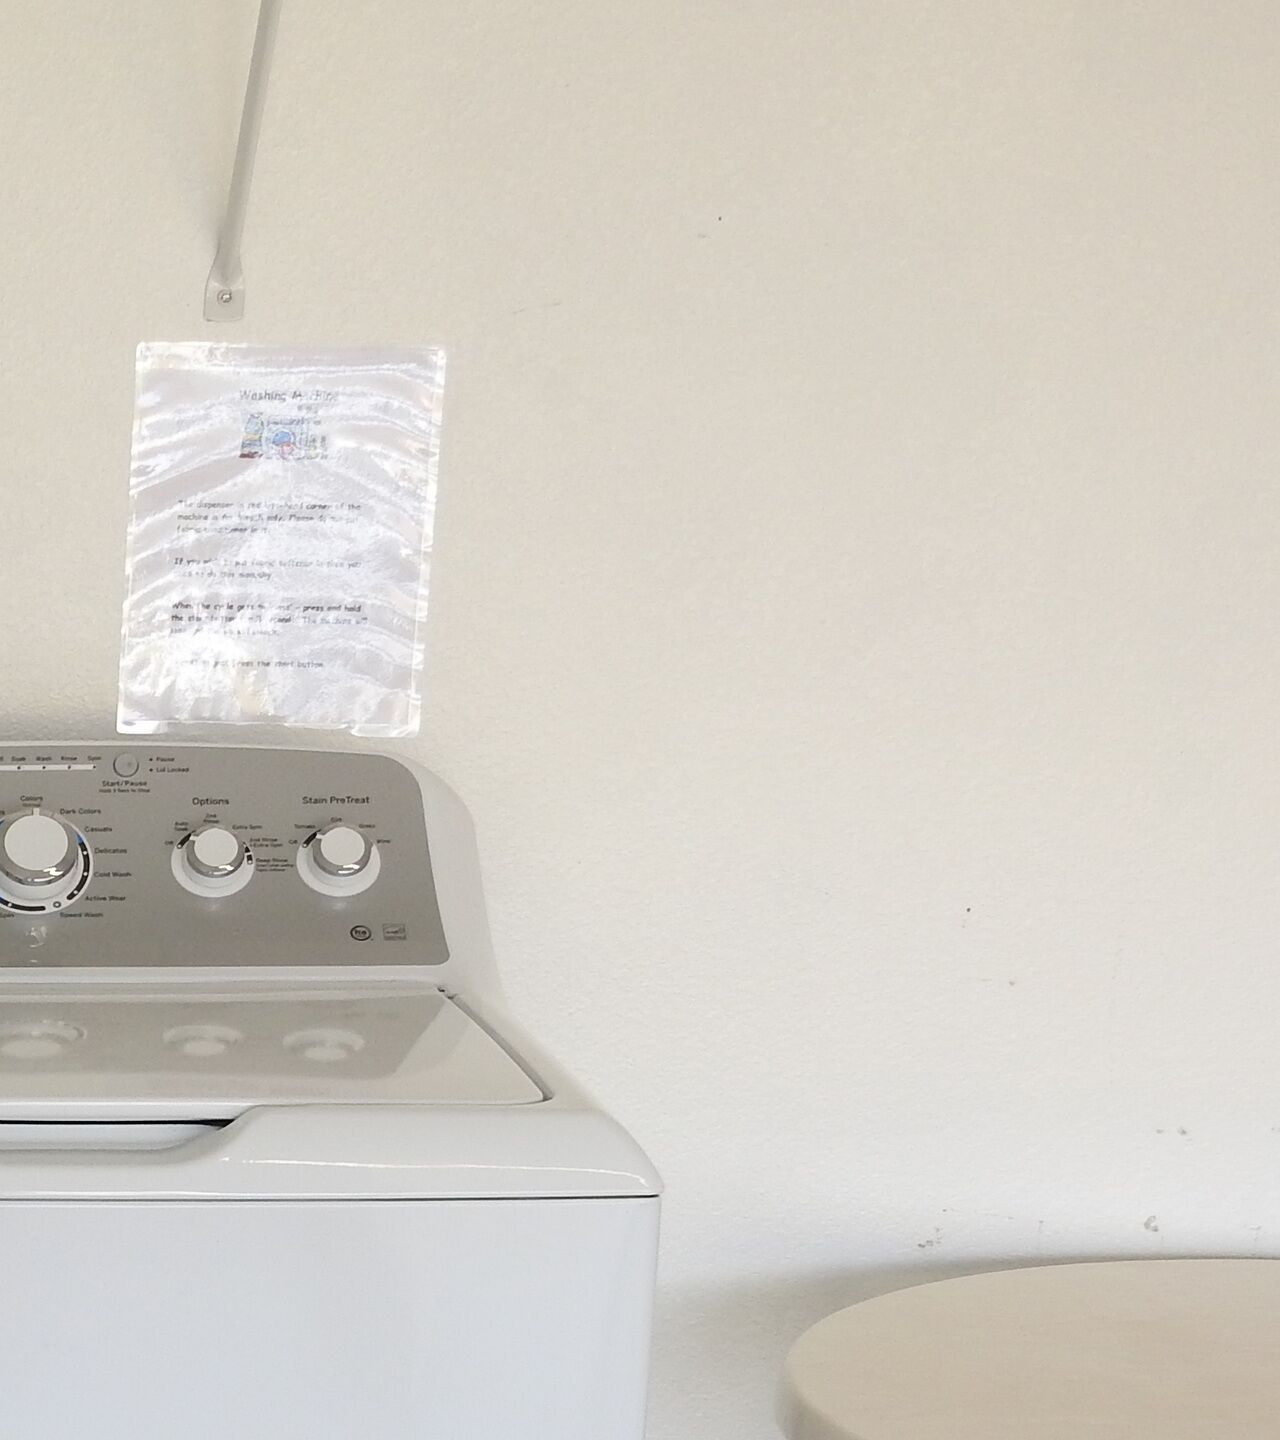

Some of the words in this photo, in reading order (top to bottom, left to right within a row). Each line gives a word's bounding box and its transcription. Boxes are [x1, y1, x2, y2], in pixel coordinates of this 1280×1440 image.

[192, 797, 230, 807] Options
[302, 796, 328, 805] Stain
[330, 796, 370, 805] PreTreat
